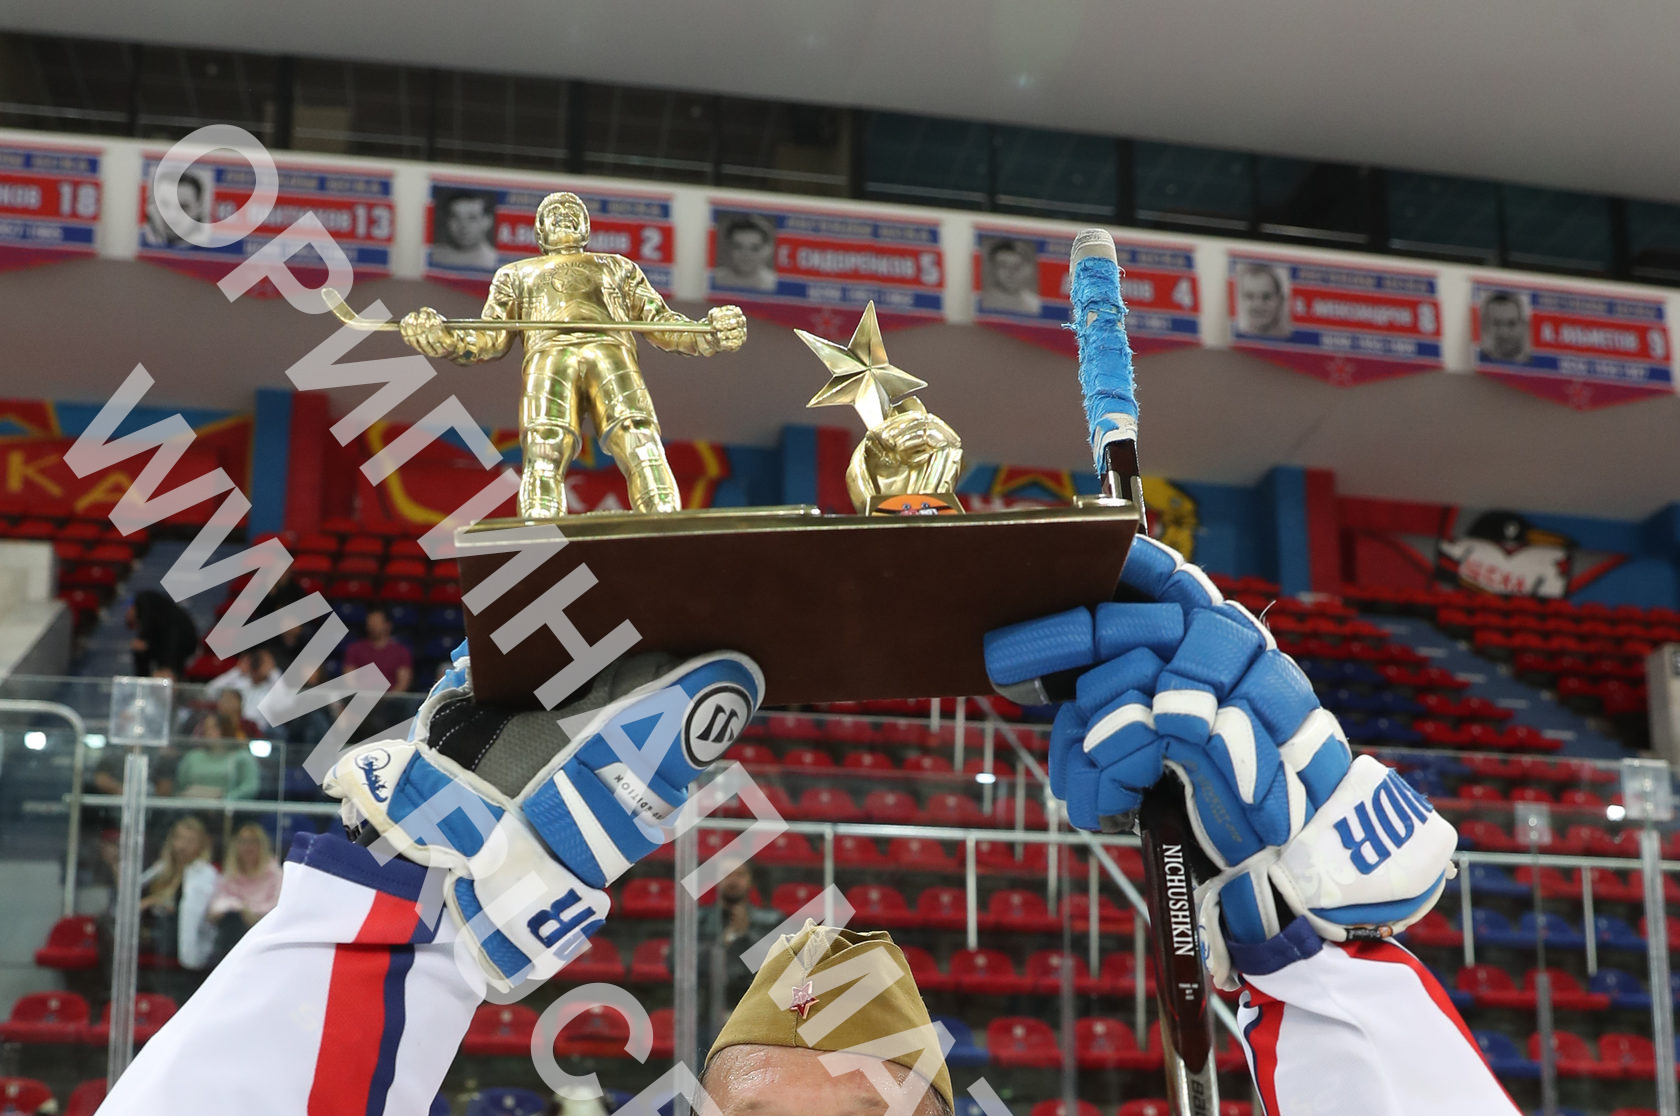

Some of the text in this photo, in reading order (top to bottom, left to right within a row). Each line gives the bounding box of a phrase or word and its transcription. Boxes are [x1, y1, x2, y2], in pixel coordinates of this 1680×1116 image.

[353, 205, 391, 239] 13
[639, 227, 662, 260] 2
[919, 252, 940, 285] 5
[1172, 277, 1194, 309] 4
[1162, 843, 1195, 957] NICHUSHKIN
